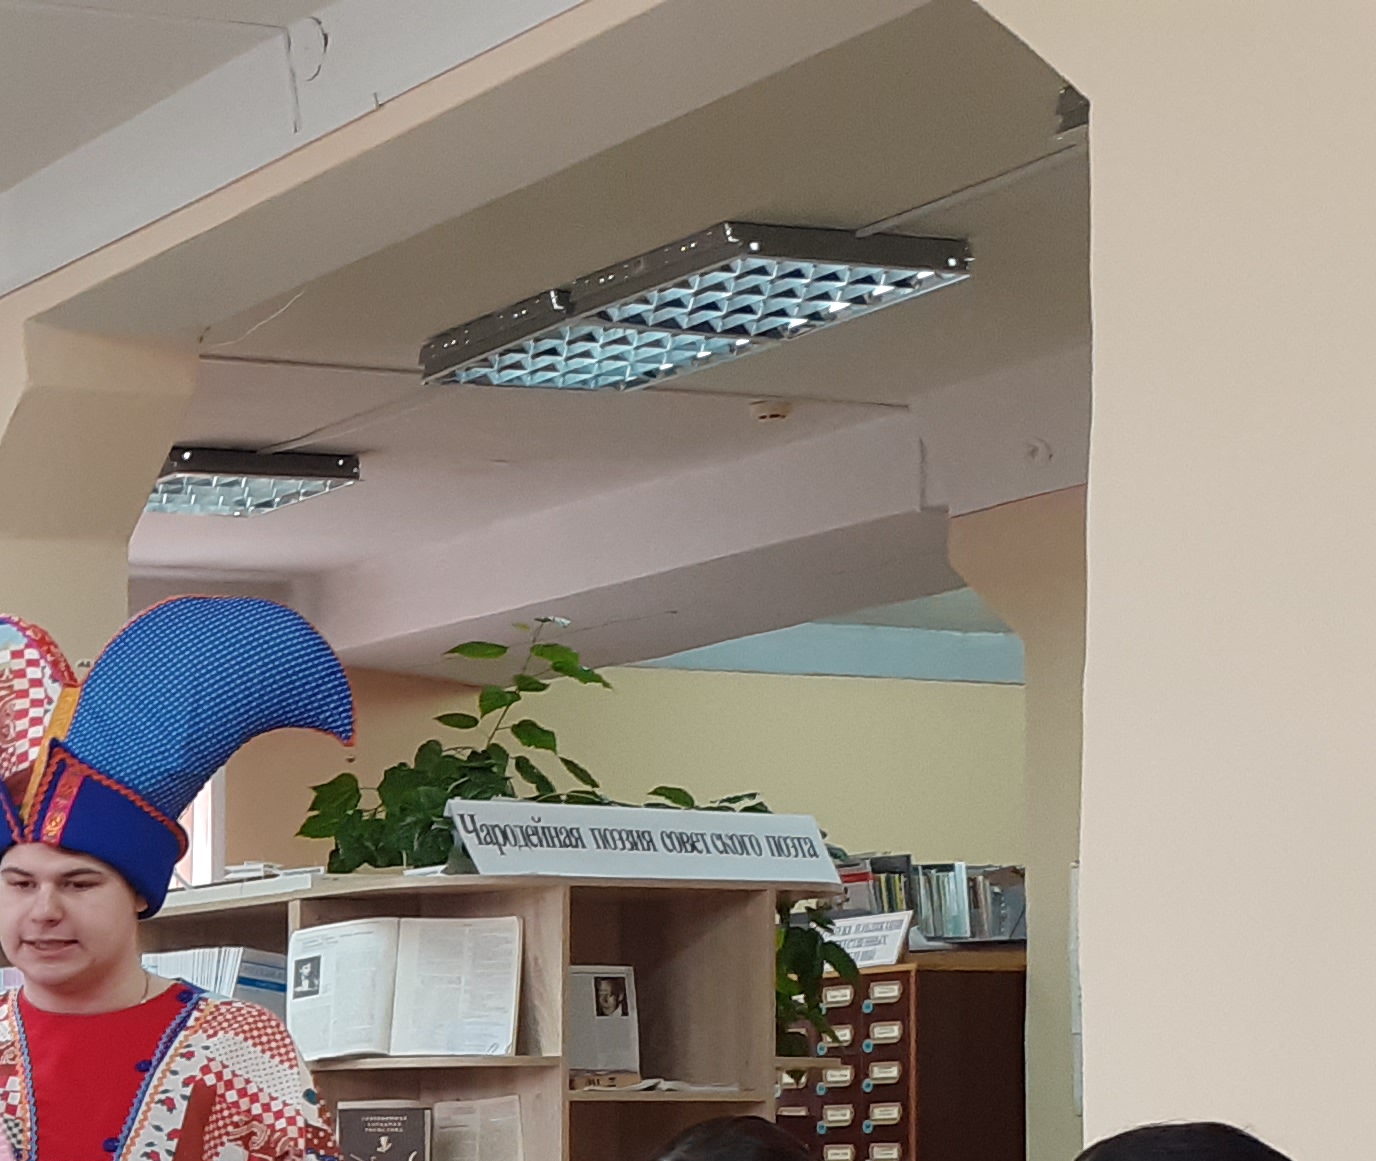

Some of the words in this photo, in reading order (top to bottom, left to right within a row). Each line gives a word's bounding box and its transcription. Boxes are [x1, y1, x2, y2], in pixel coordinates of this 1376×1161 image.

[458, 813, 587, 856] Чародейная
[589, 827, 658, 853] поэзия
[764, 835, 820, 859] поэта
